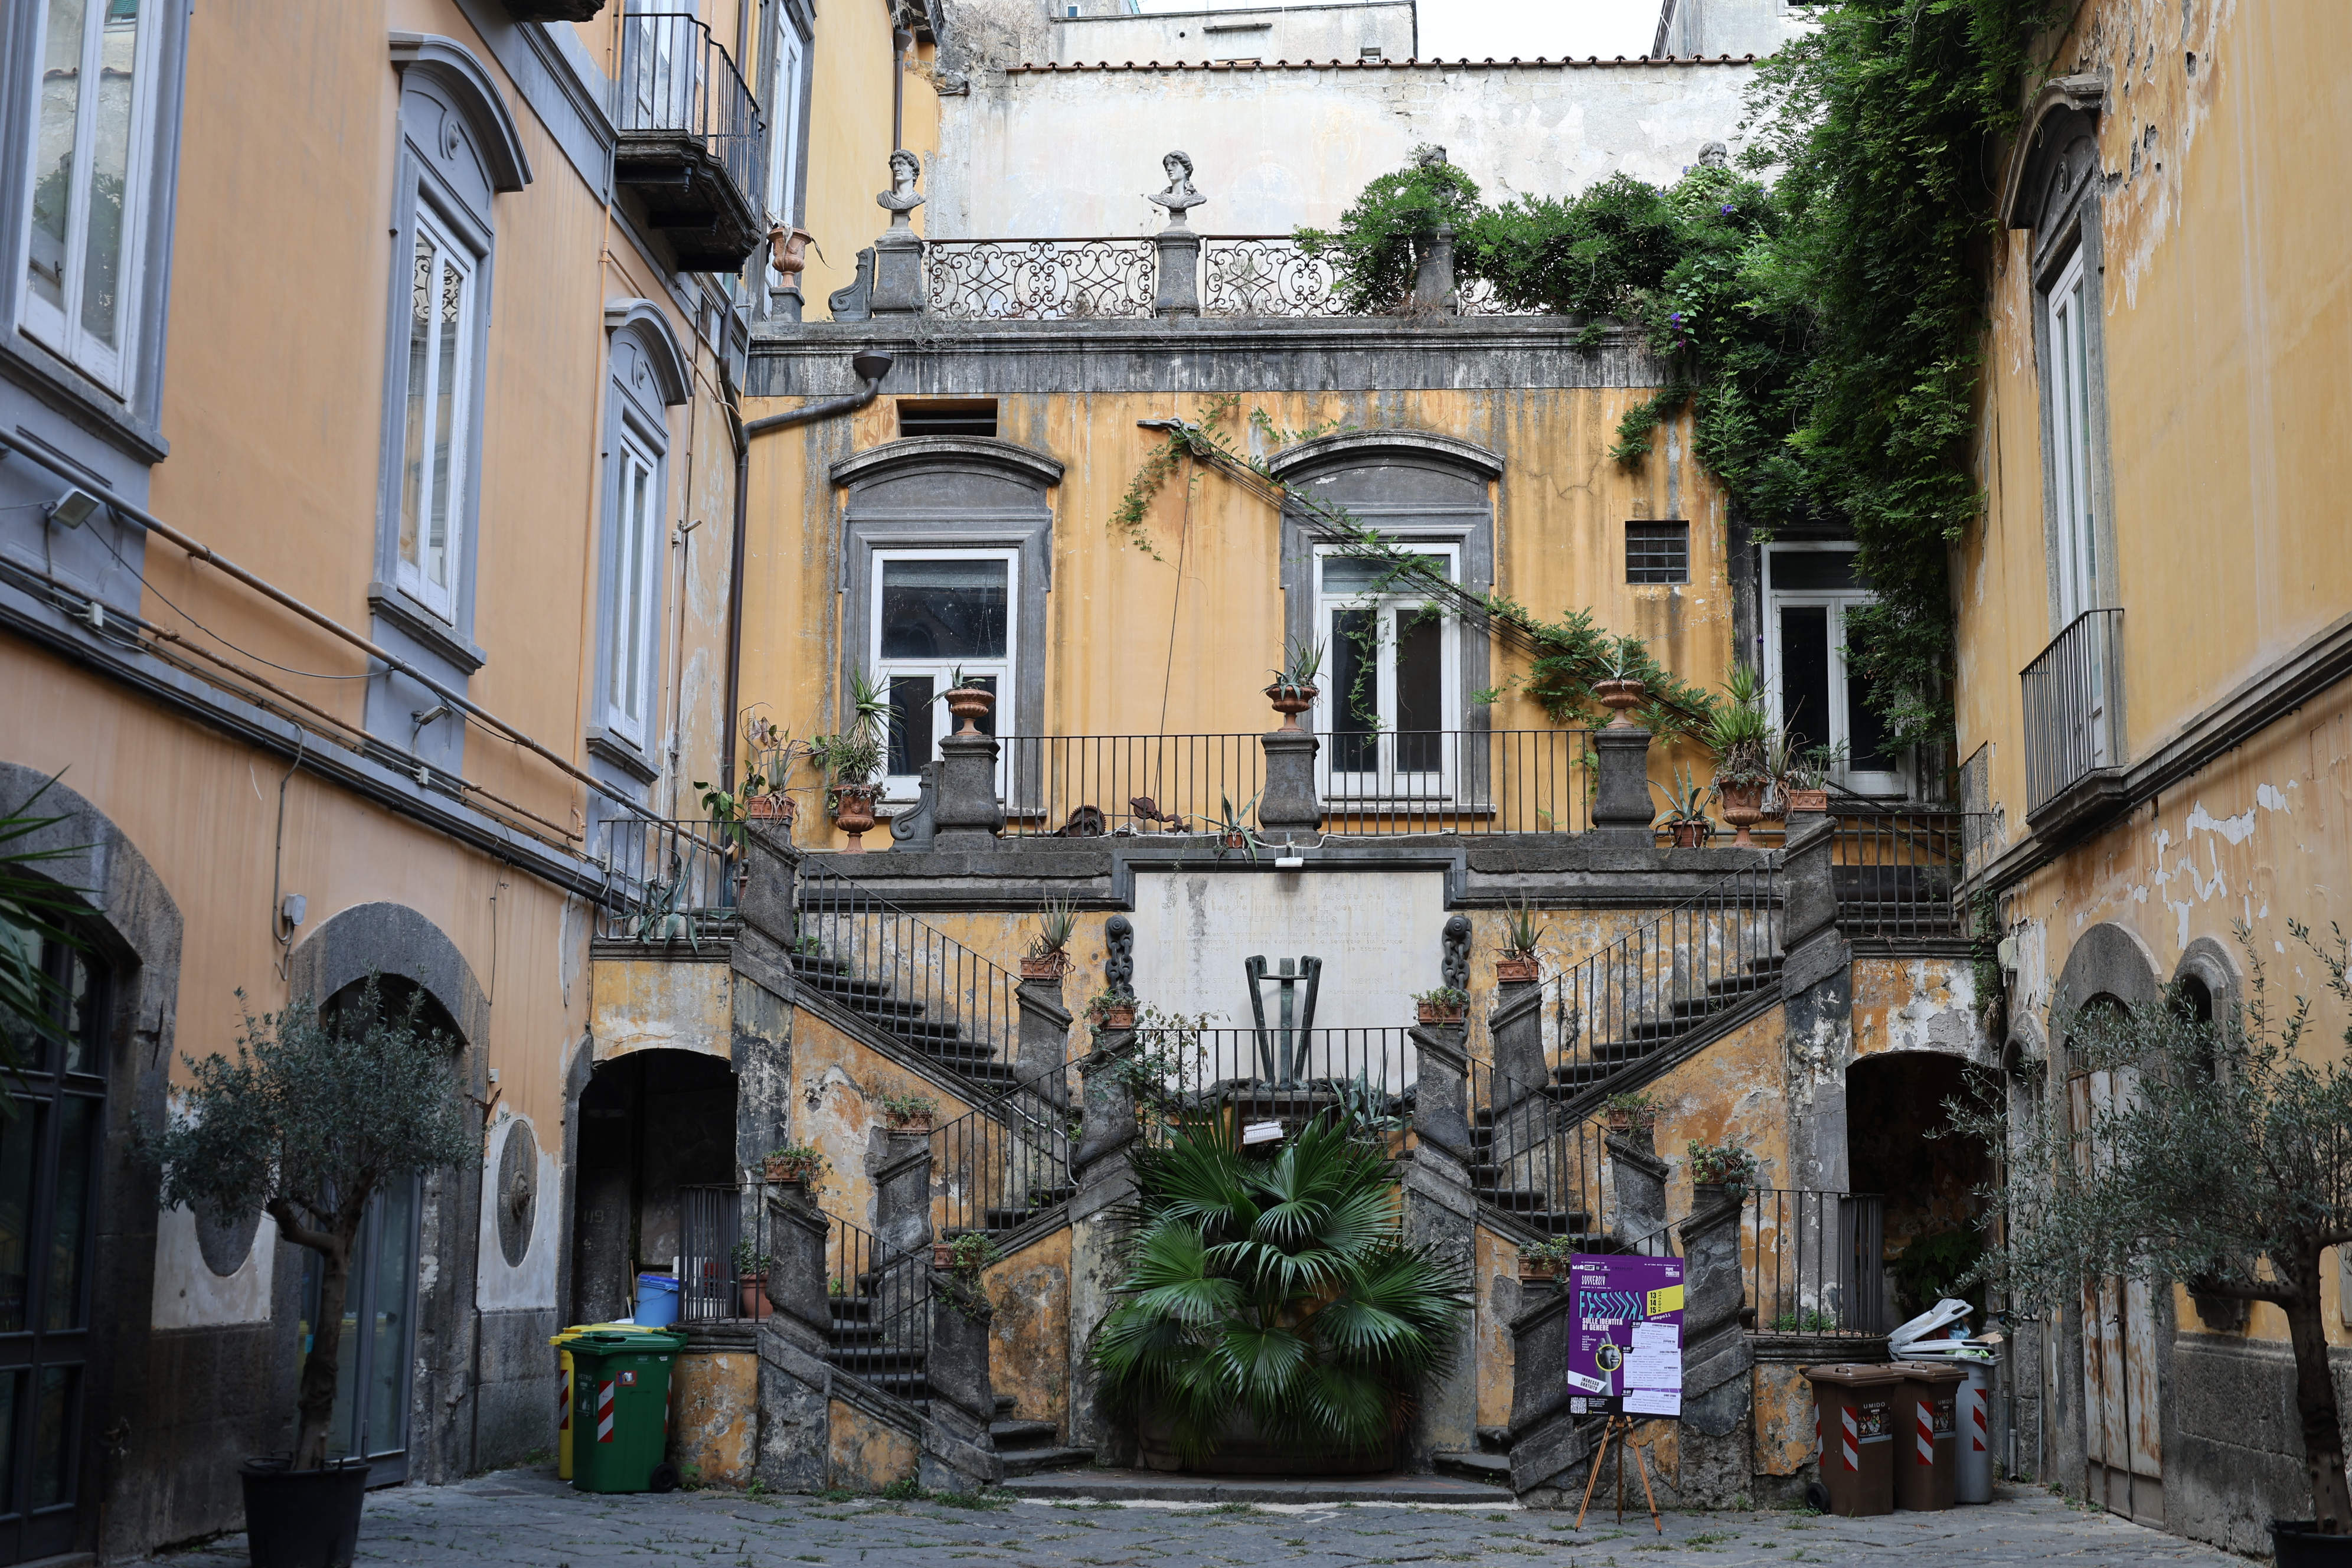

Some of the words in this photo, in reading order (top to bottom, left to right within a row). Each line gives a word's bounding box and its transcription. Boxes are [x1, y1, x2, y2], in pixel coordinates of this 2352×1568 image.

[1579, 1291, 1644, 1320] FESTIVAL
[1599, 1317, 1623, 1325] IDENTITÀ
[1651, 1313, 1671, 1321] @Napoli
[1580, 1381, 1598, 1391] GRATUITO
[1582, 1377, 1599, 1386] INGRESSO
